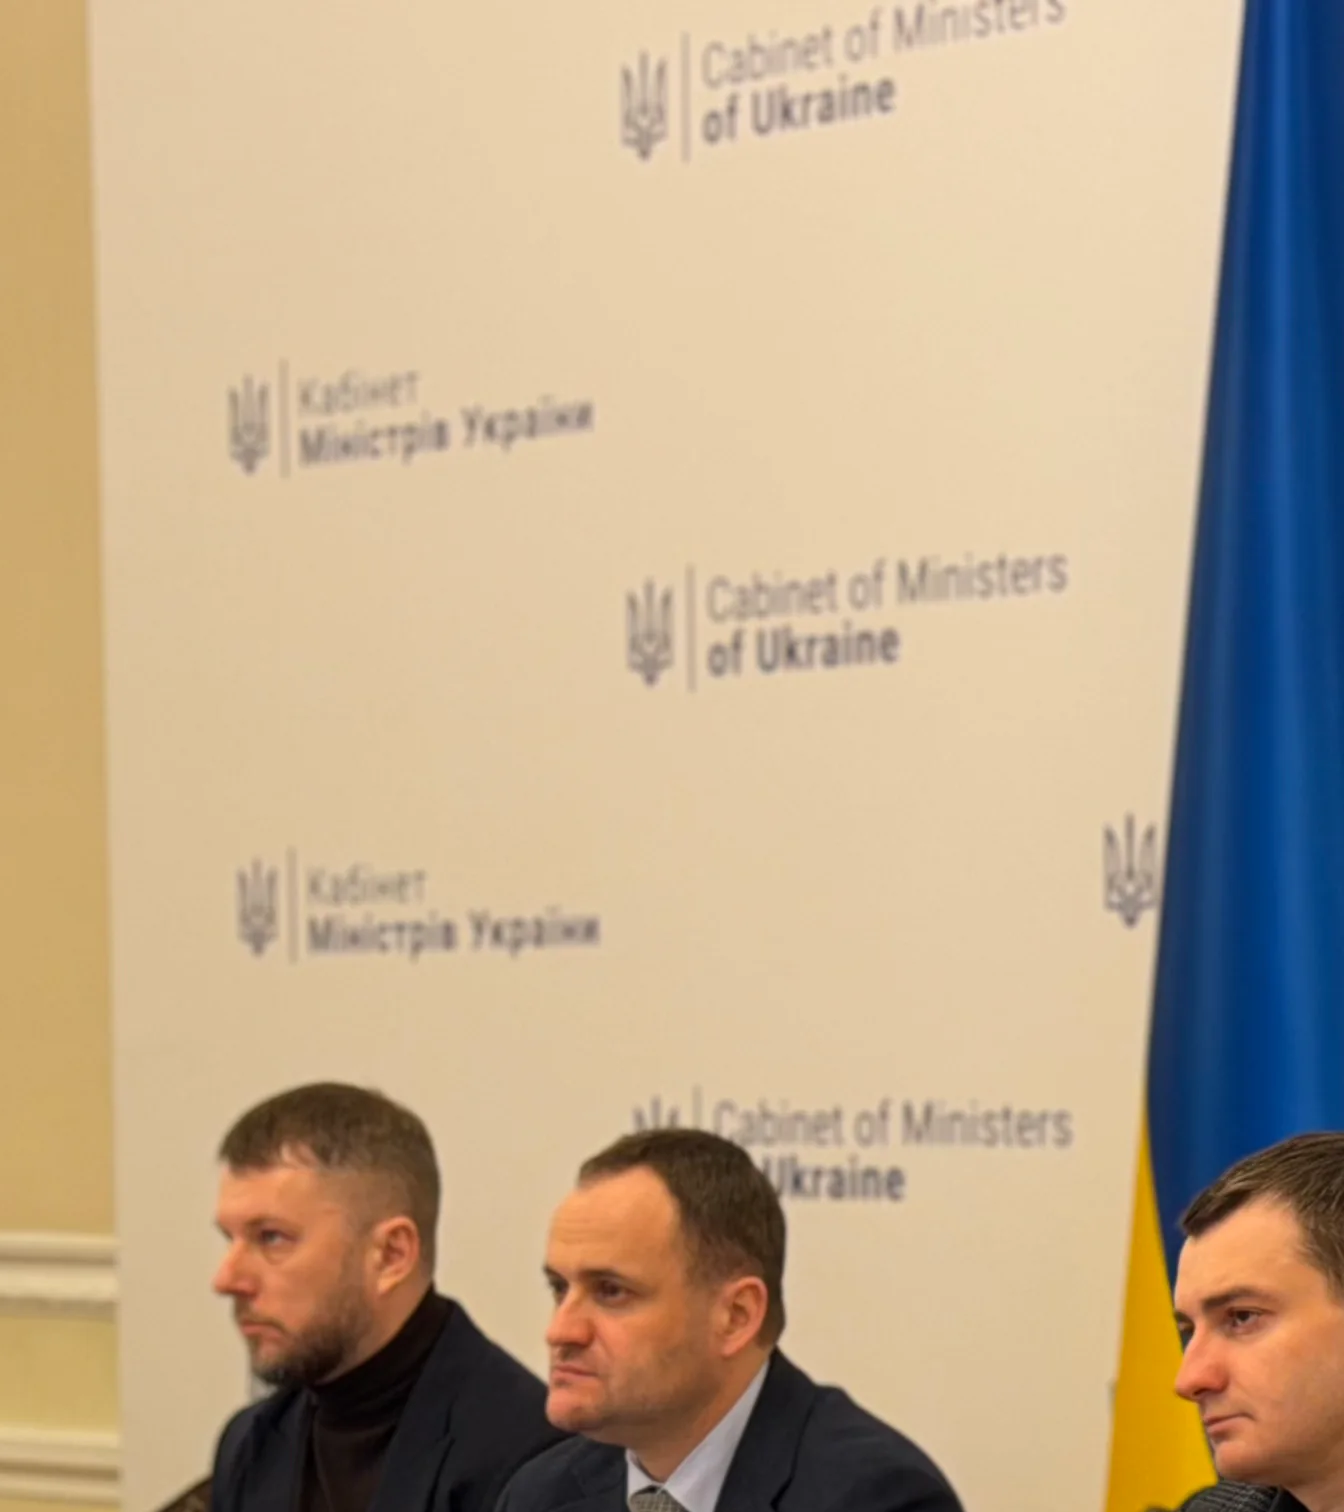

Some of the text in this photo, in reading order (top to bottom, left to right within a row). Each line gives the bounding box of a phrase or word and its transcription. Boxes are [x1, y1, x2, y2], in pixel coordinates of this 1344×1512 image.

[702, 0, 1066, 89] Cabinet of Ministers
[702, 75, 895, 144] of Ukraine
[298, 369, 419, 415] Кабінет
[299, 394, 593, 466] Міністрів України
[707, 552, 1068, 623] Cabinet of Ministers
[708, 621, 900, 676] of Ukraine
[308, 864, 426, 906] Кабінет
[308, 906, 601, 963] Міністрів України
[714, 1097, 1074, 1149] Cabinet of Ministers
[764, 1155, 905, 1201] Ukraine
